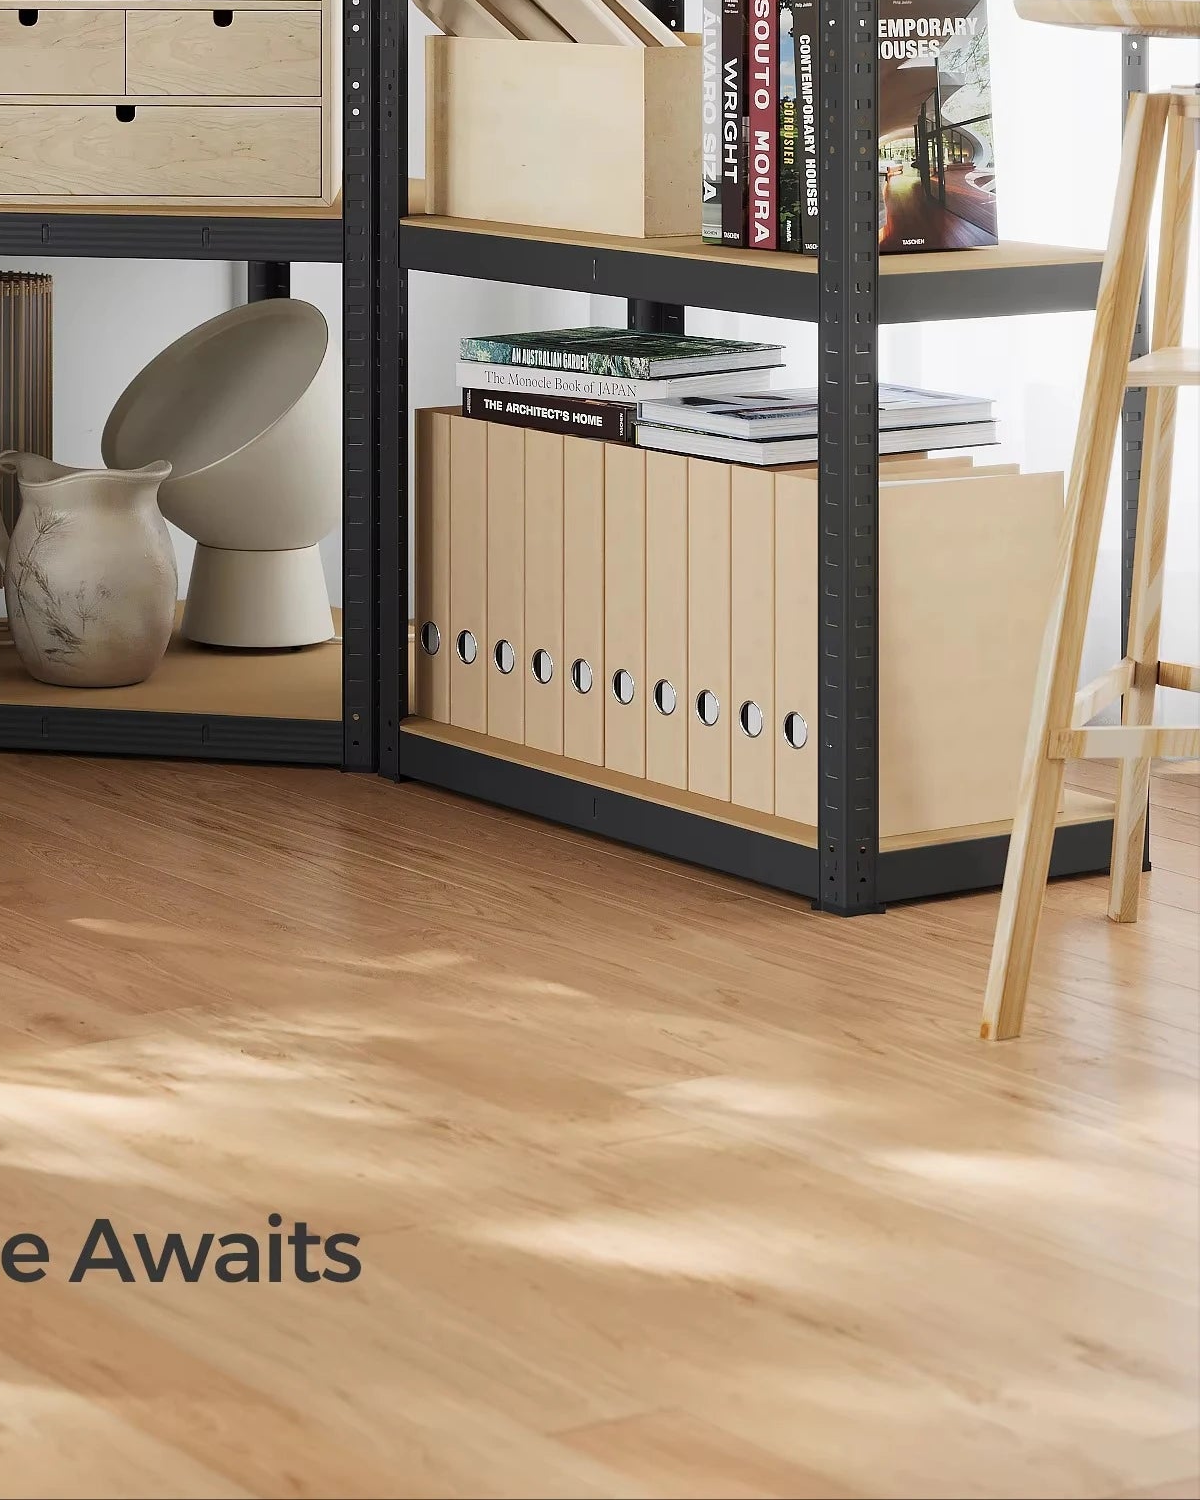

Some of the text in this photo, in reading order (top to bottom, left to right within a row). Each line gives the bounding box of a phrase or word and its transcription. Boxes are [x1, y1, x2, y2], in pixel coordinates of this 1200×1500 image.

[878, 40, 940, 60] OUSES
[724, 57, 738, 184] WRIGHT
[783, 101, 795, 165] CORBUSIER
[799, 34, 818, 217] CONTEMPORARY HOUSES
[703, 132, 717, 203] SIZA
[754, 130, 770, 243] MOURA
[902, 238, 925, 246] TASCHEN
[511, 347, 589, 371] AN AUSTRALIAN GARDEN
[485, 370, 637, 397] The Monocle Book of JAPAN
[483, 398, 503, 412] THE
[505, 402, 570, 422] ARCHITECT'S
[572, 413, 603, 427] HOME
